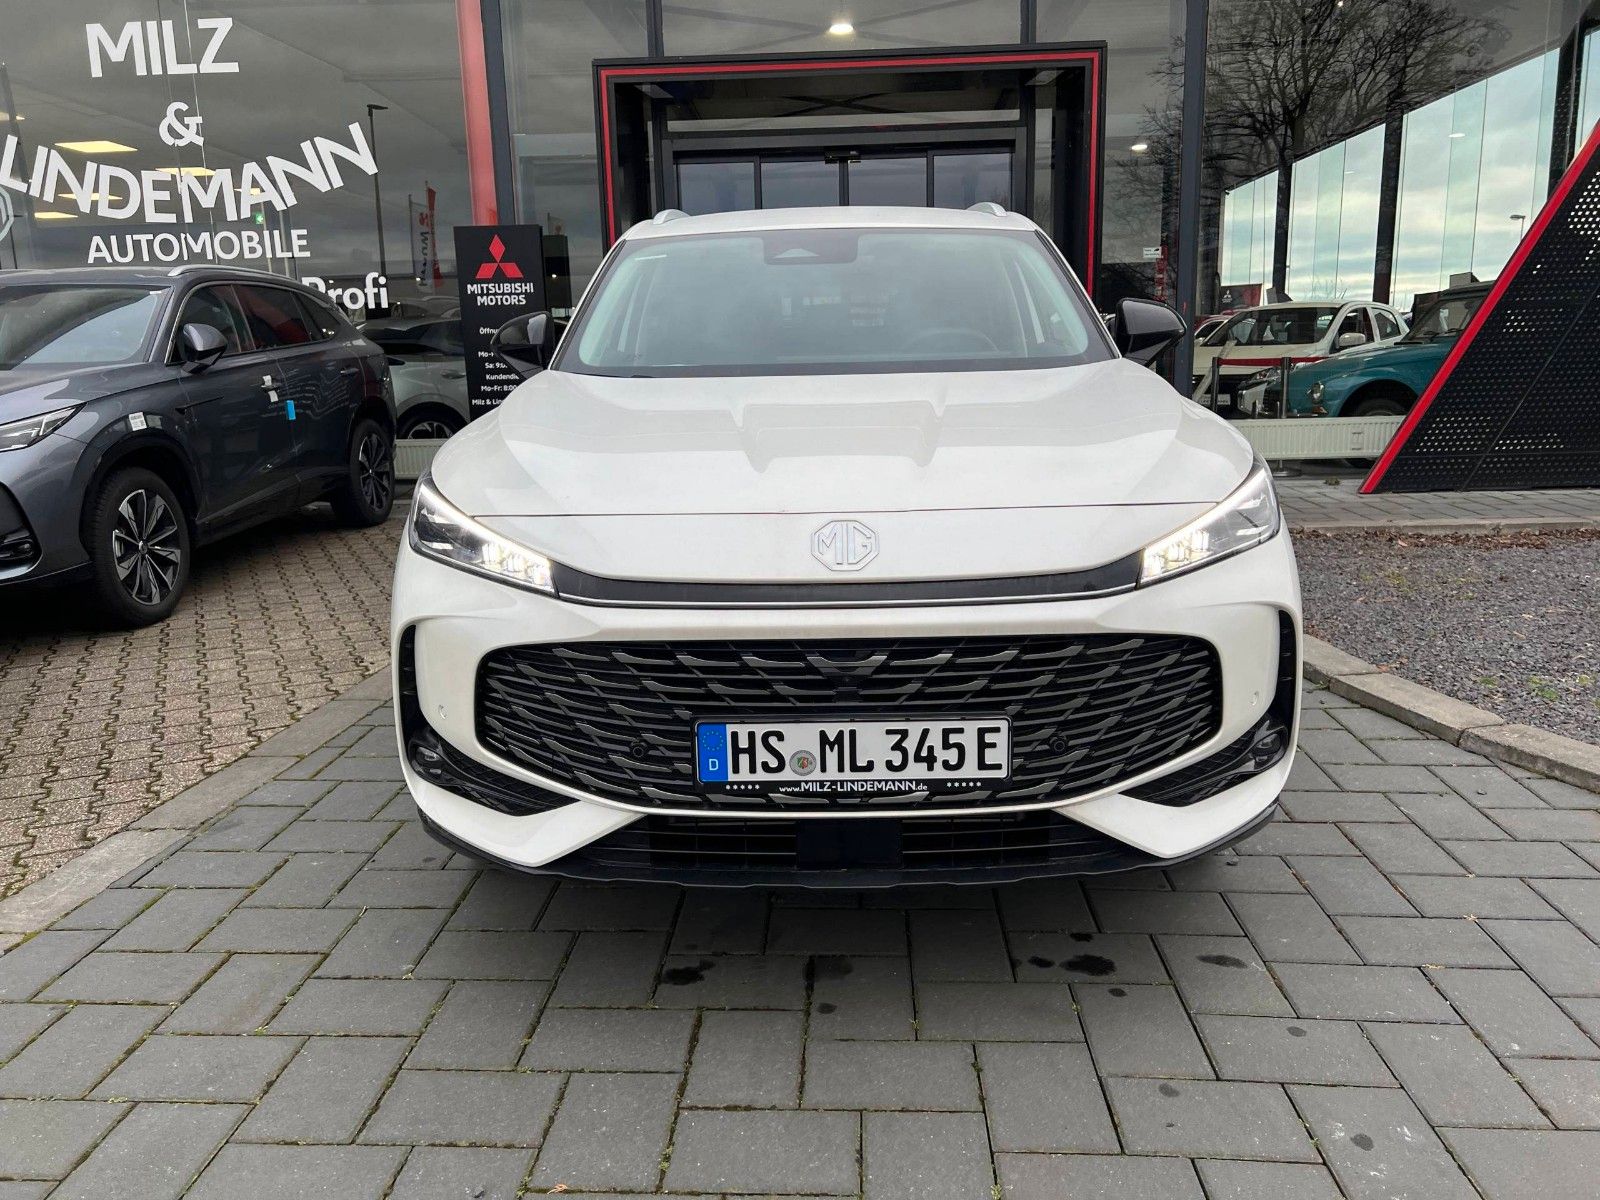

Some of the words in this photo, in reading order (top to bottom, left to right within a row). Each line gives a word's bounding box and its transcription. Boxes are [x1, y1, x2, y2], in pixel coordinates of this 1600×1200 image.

[85, 17, 240, 78] MILZ
[158, 101, 205, 147] &
[0, 122, 379, 224] LINDEMANN
[87, 228, 311, 264] AUTOMOBILE
[466, 282, 534, 295] MITSUBISHI
[477, 295, 526, 306] MOTORS
[817, 523, 873, 566] MG
[708, 758, 720, 771] D
[730, 729, 787, 774] HS
[819, 728, 875, 773] ML
[778, 780, 928, 793] www.MILZ-LINDEMANN.de
